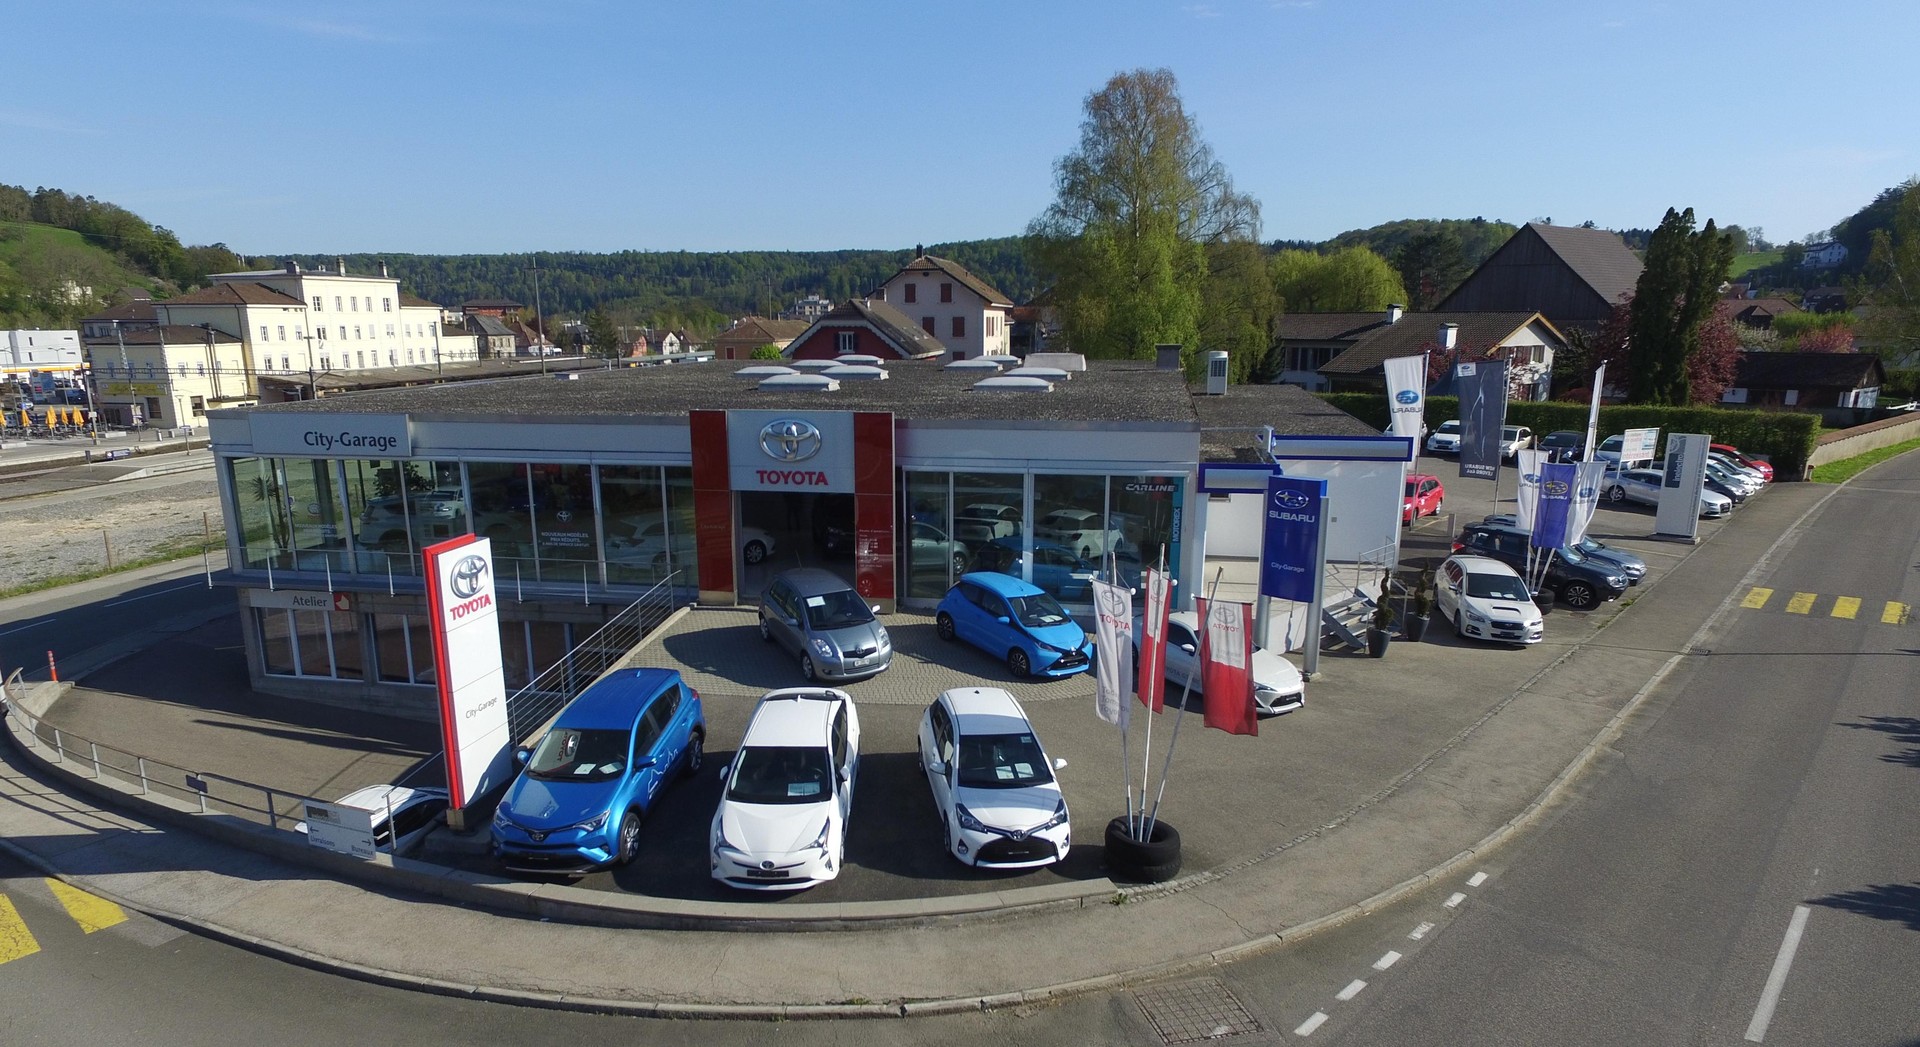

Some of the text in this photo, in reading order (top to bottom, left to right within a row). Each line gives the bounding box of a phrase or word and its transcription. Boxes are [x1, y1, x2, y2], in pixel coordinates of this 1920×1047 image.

[303, 431, 397, 452] City-Garage
[756, 470, 829, 485] TOYOTA
[1125, 483, 1175, 492] CARLINE
[1172, 507, 1181, 542] MOTOREX
[1269, 510, 1315, 523] SUBARU
[1271, 562, 1305, 573] City-Garage
[292, 595, 328, 607] Atelier
[450, 594, 491, 621] TOYOTA
[1100, 614, 1131, 631] TOYOTA
[465, 697, 498, 719] City-Garage
